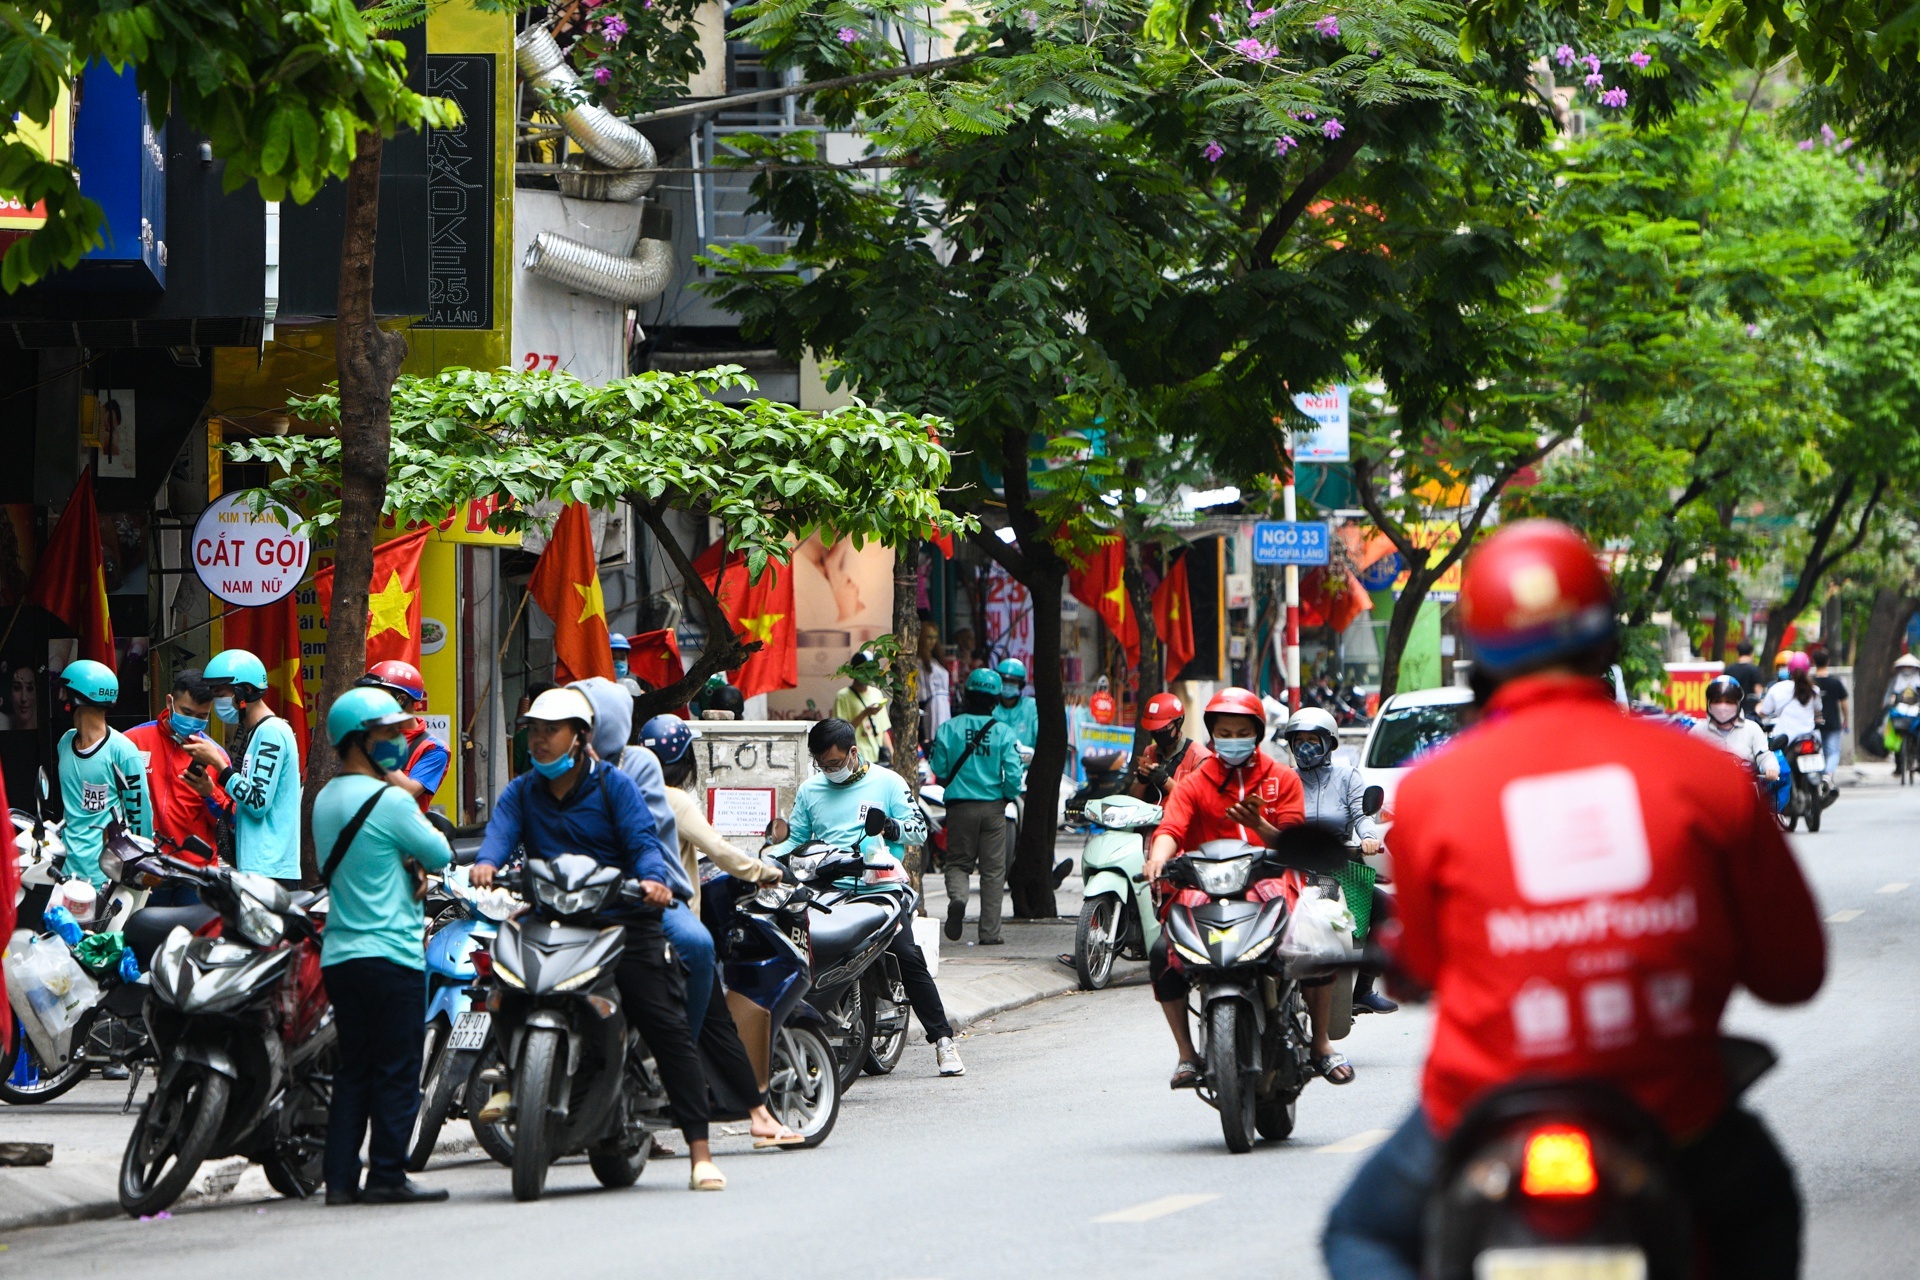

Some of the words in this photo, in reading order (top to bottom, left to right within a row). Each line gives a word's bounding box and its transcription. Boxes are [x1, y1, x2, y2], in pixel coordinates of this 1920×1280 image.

[430, 277, 469, 304] 25
[447, 307, 477, 323] LÁNG
[525, 353, 559, 372] 27
[218, 512, 239, 523] KIM
[1301, 530, 1319, 545] 33
[196, 532, 245, 567] CẮT
[255, 534, 304, 574] GỘI
[222, 580, 253, 593] NAM
[261, 577, 283, 593] NỮ
[298, 615, 314, 630] ái
[965, 729, 992, 743] BE
[707, 741, 789, 775] LOL
[84, 789, 105, 800] BAE
